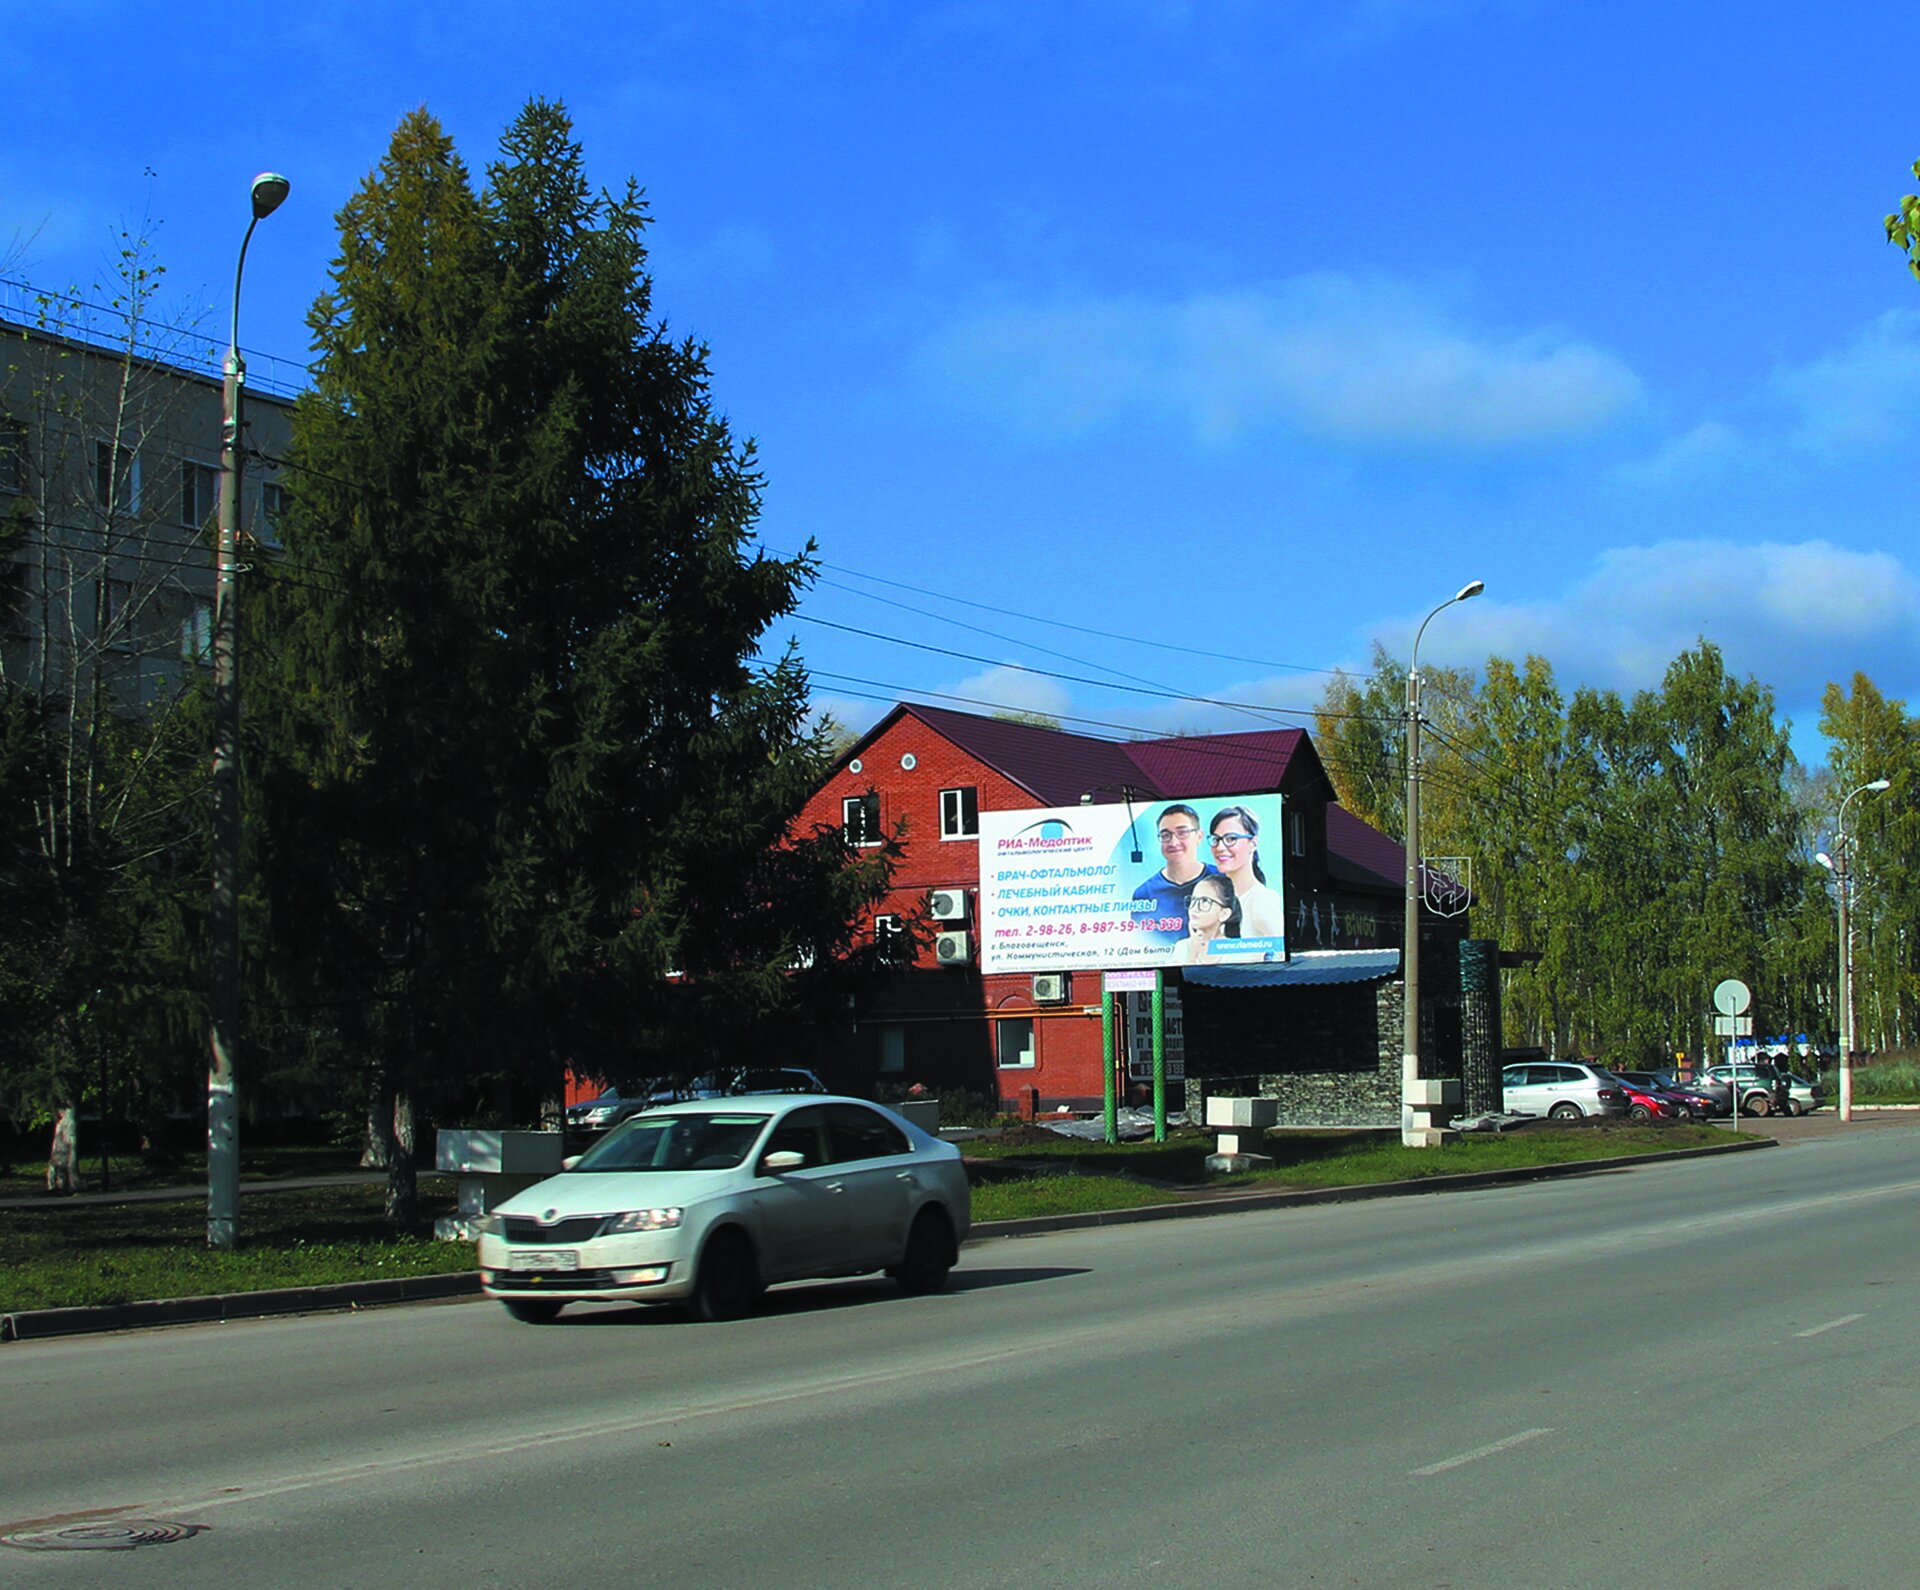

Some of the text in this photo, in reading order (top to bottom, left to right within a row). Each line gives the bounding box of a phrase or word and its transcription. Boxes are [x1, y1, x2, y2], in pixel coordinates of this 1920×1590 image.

[998, 837, 1093, 849] РИА-Медоптик
[997, 865, 1117, 881] ВРАЧ-ОФТАЛЬМОЛОГ
[997, 884, 1116, 899] ЛЕЧЕБНЫЙ КАБИНЕТ
[998, 898, 1157, 918] ОЧКИ, КОНТАКТНЫЕ ЛИНЗЫ
[994, 918, 1182, 938] тел. 2-98-26, 8-987-59-12-333
[991, 954, 1003, 962] ул.
[1006, 950, 1100, 961] Коммунистическая,
[1104, 948, 1114, 956] 12
[1117, 947, 1141, 956] (Дом
